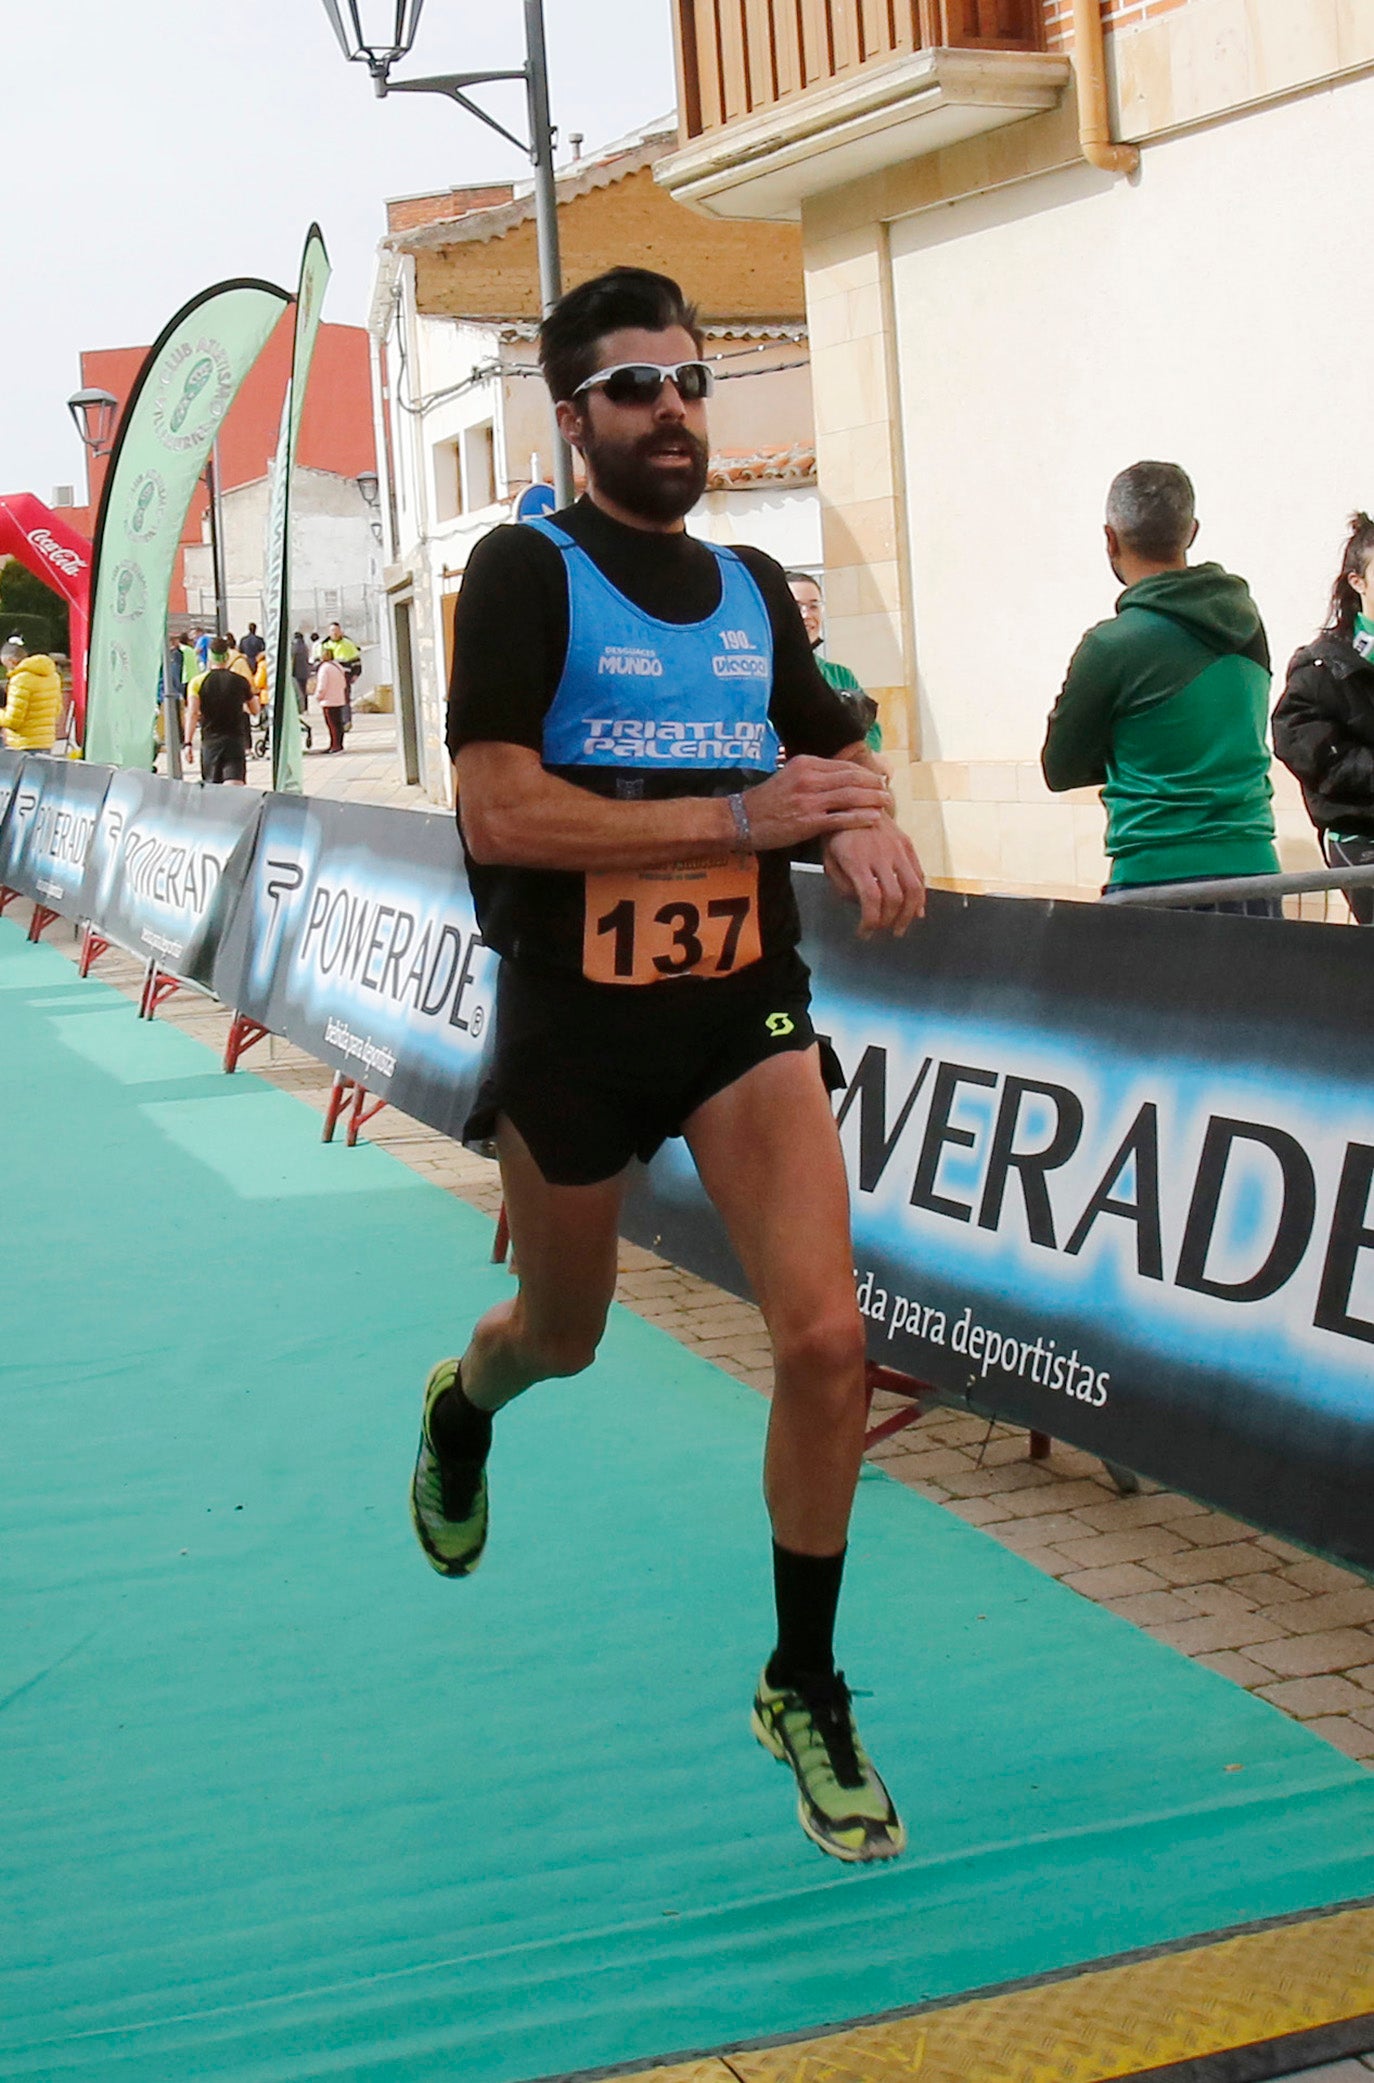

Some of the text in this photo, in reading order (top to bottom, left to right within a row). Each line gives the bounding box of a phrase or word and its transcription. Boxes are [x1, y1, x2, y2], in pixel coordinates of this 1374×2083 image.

[598, 656, 663, 677] MUNDO
[124, 831, 221, 914] POWERAD
[597, 896, 750, 977] 137
[853, 1269, 1111, 1408] da para deportistas
